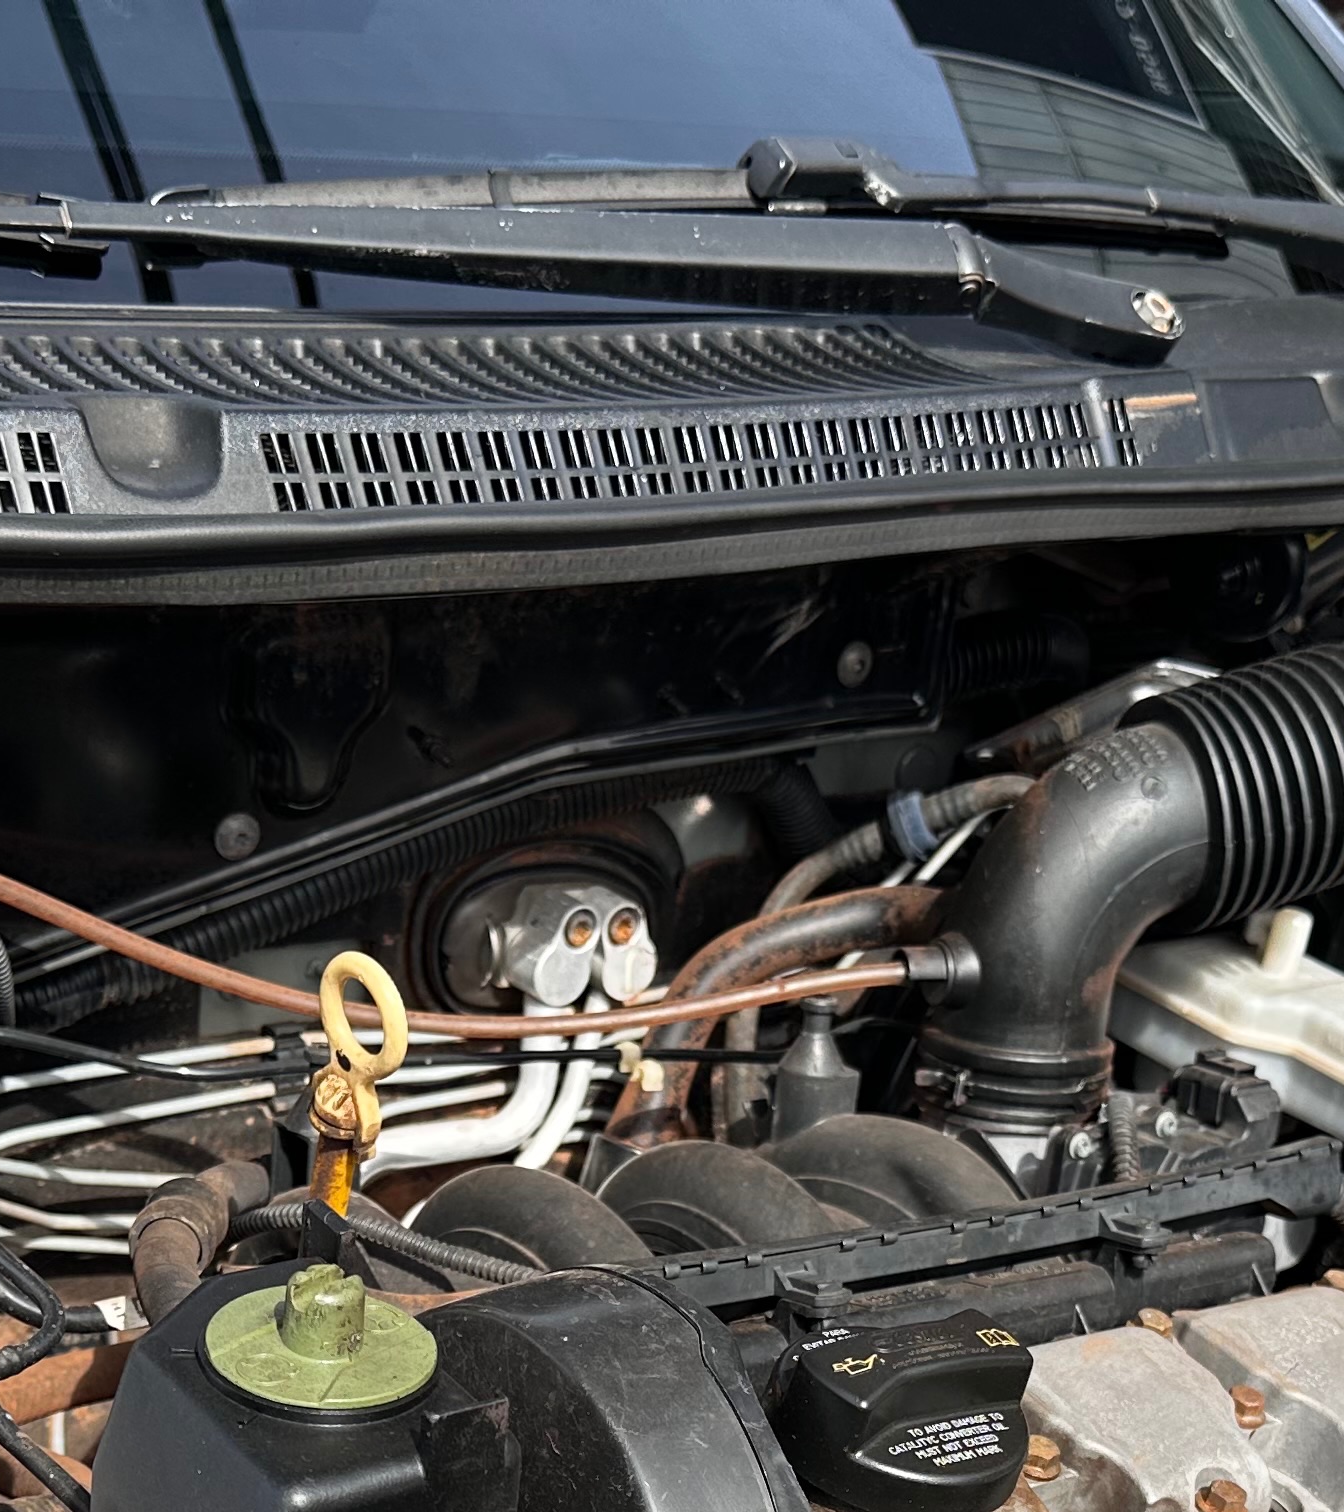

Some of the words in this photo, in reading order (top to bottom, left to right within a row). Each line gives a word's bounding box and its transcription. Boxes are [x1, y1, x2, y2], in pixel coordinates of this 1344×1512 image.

[907, 1427, 923, 1438] TO
[924, 1421, 951, 1436] AVOID
[950, 1414, 988, 1431] DAMAGE
[988, 1411, 1004, 1423] TO
[939, 1424, 992, 1444] CONVERTER
[991, 1421, 1010, 1433] OIL
[915, 1445, 942, 1460] MUST
[943, 1440, 964, 1453] NOT
[963, 1434, 1000, 1449] EXCEED
[932, 1450, 978, 1467] MAXIMUM
[977, 1443, 1004, 1458] MARK
